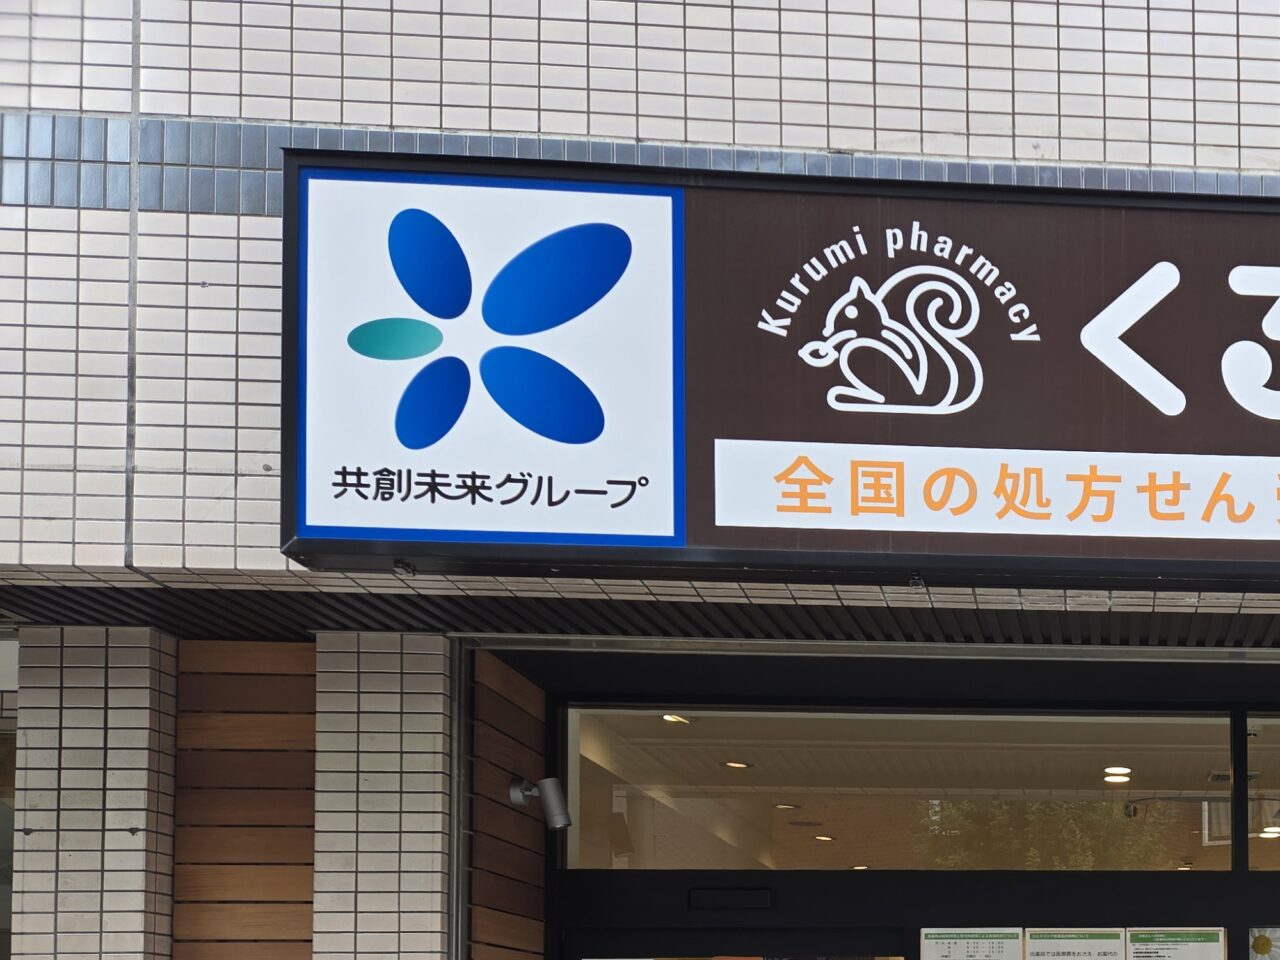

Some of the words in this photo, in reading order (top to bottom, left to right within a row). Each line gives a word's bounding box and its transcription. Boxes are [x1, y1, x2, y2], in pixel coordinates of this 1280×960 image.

[757, 225, 869, 337] Kurumi
[886, 221, 1041, 344] pharmacy
[331, 465, 650, 510] 共創未来グループ
